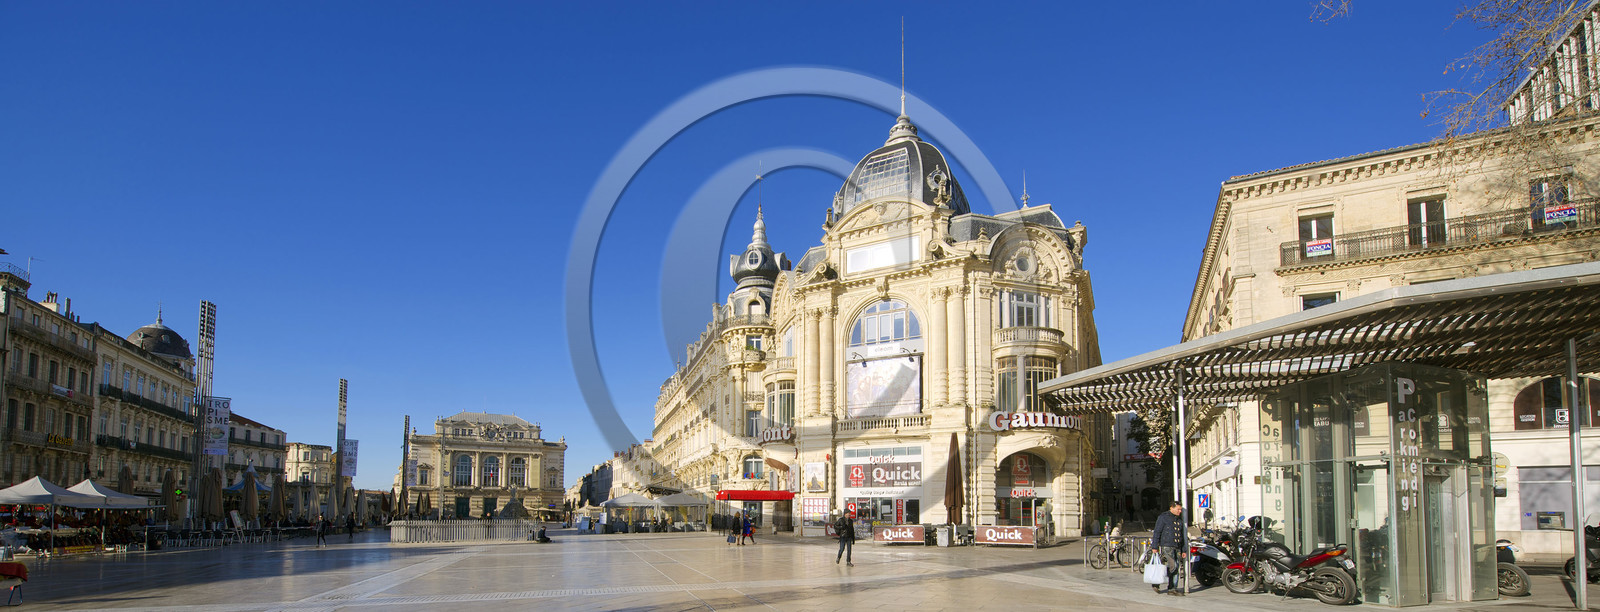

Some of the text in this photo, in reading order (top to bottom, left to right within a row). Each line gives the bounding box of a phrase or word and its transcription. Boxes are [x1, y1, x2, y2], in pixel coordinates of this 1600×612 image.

[1546, 208, 1576, 219] FONCIA
[1306, 242, 1331, 252] FONCIA
[206, 416, 229, 425] SME
[869, 454, 895, 464] Quick
[872, 466, 920, 483] Quick
[1011, 489, 1037, 498] Quick
[883, 528, 914, 540] Quick
[985, 528, 1022, 541] Quick
